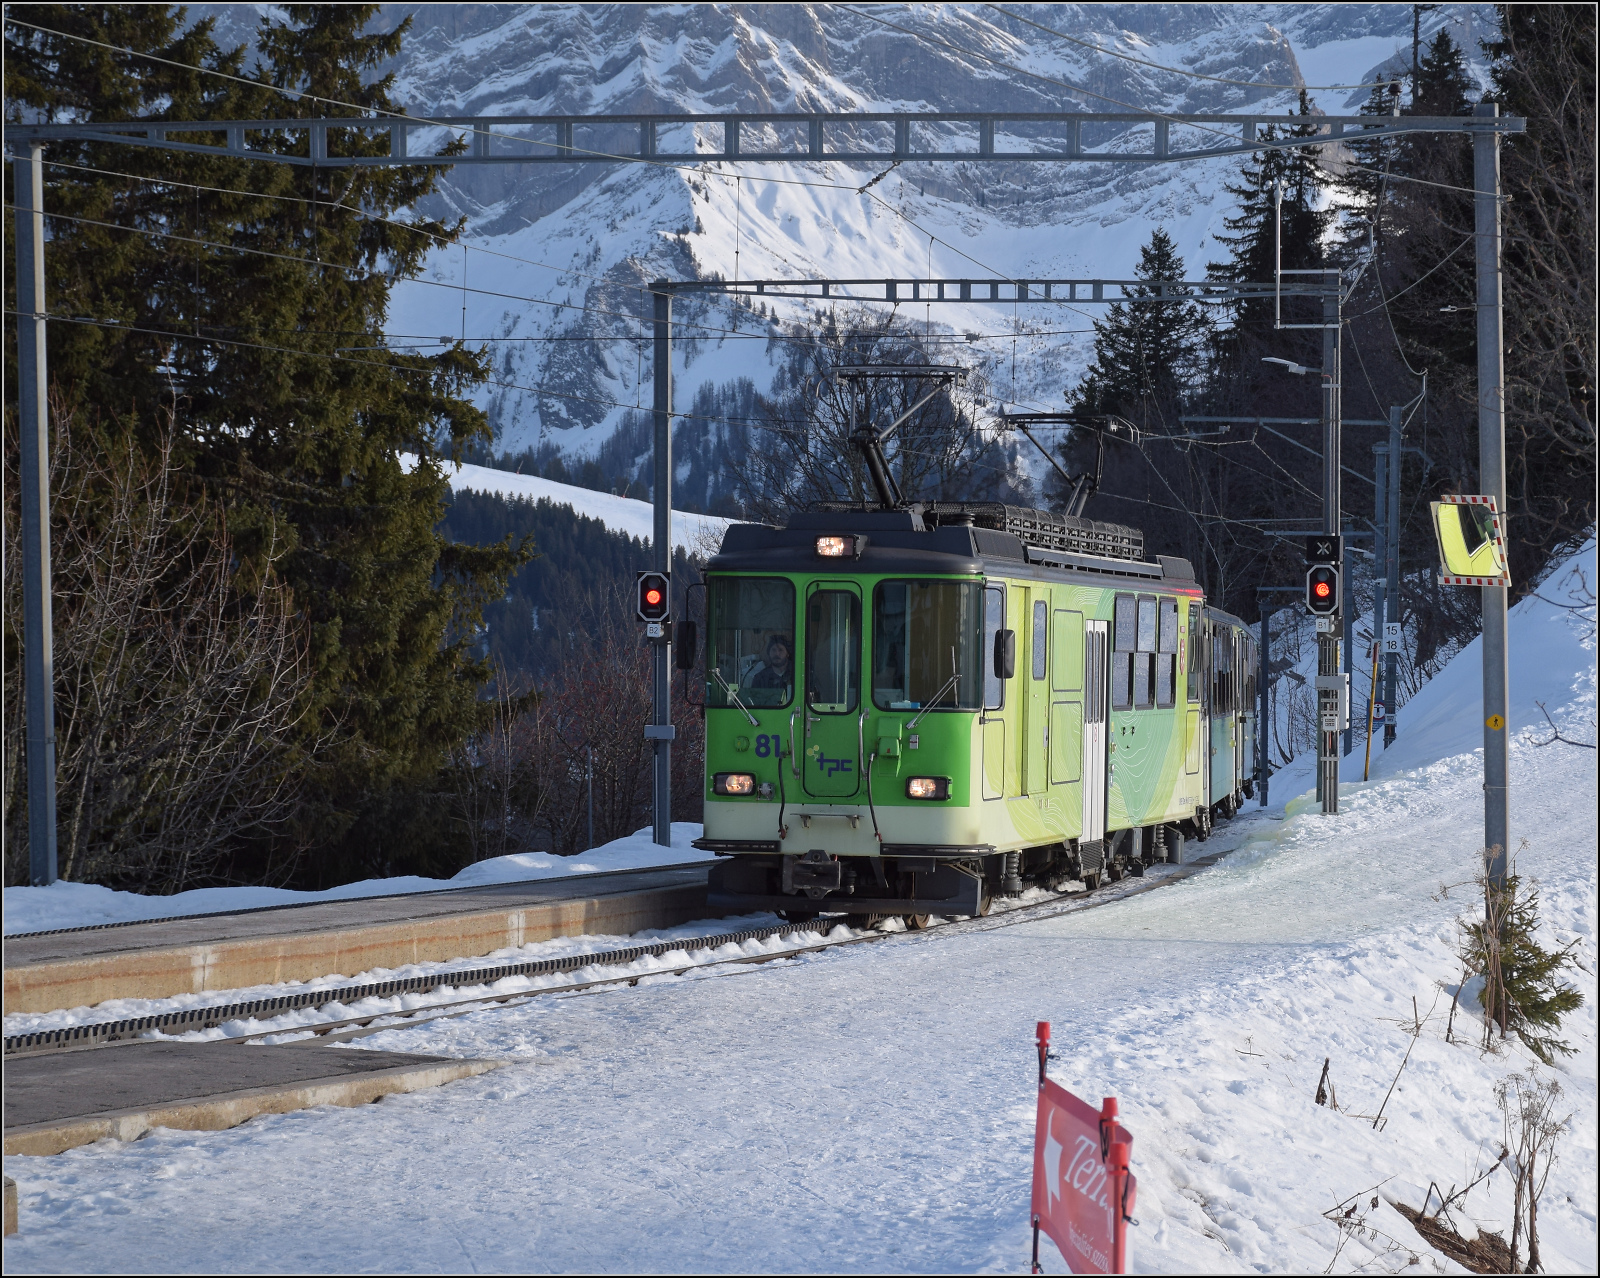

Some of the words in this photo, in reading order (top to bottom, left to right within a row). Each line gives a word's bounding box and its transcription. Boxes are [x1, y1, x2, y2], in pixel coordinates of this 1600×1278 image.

[1386, 625, 1398, 636] 15
[1386, 640, 1398, 650] 18
[755, 734, 780, 758] 81
[816, 752, 853, 777] tpc
